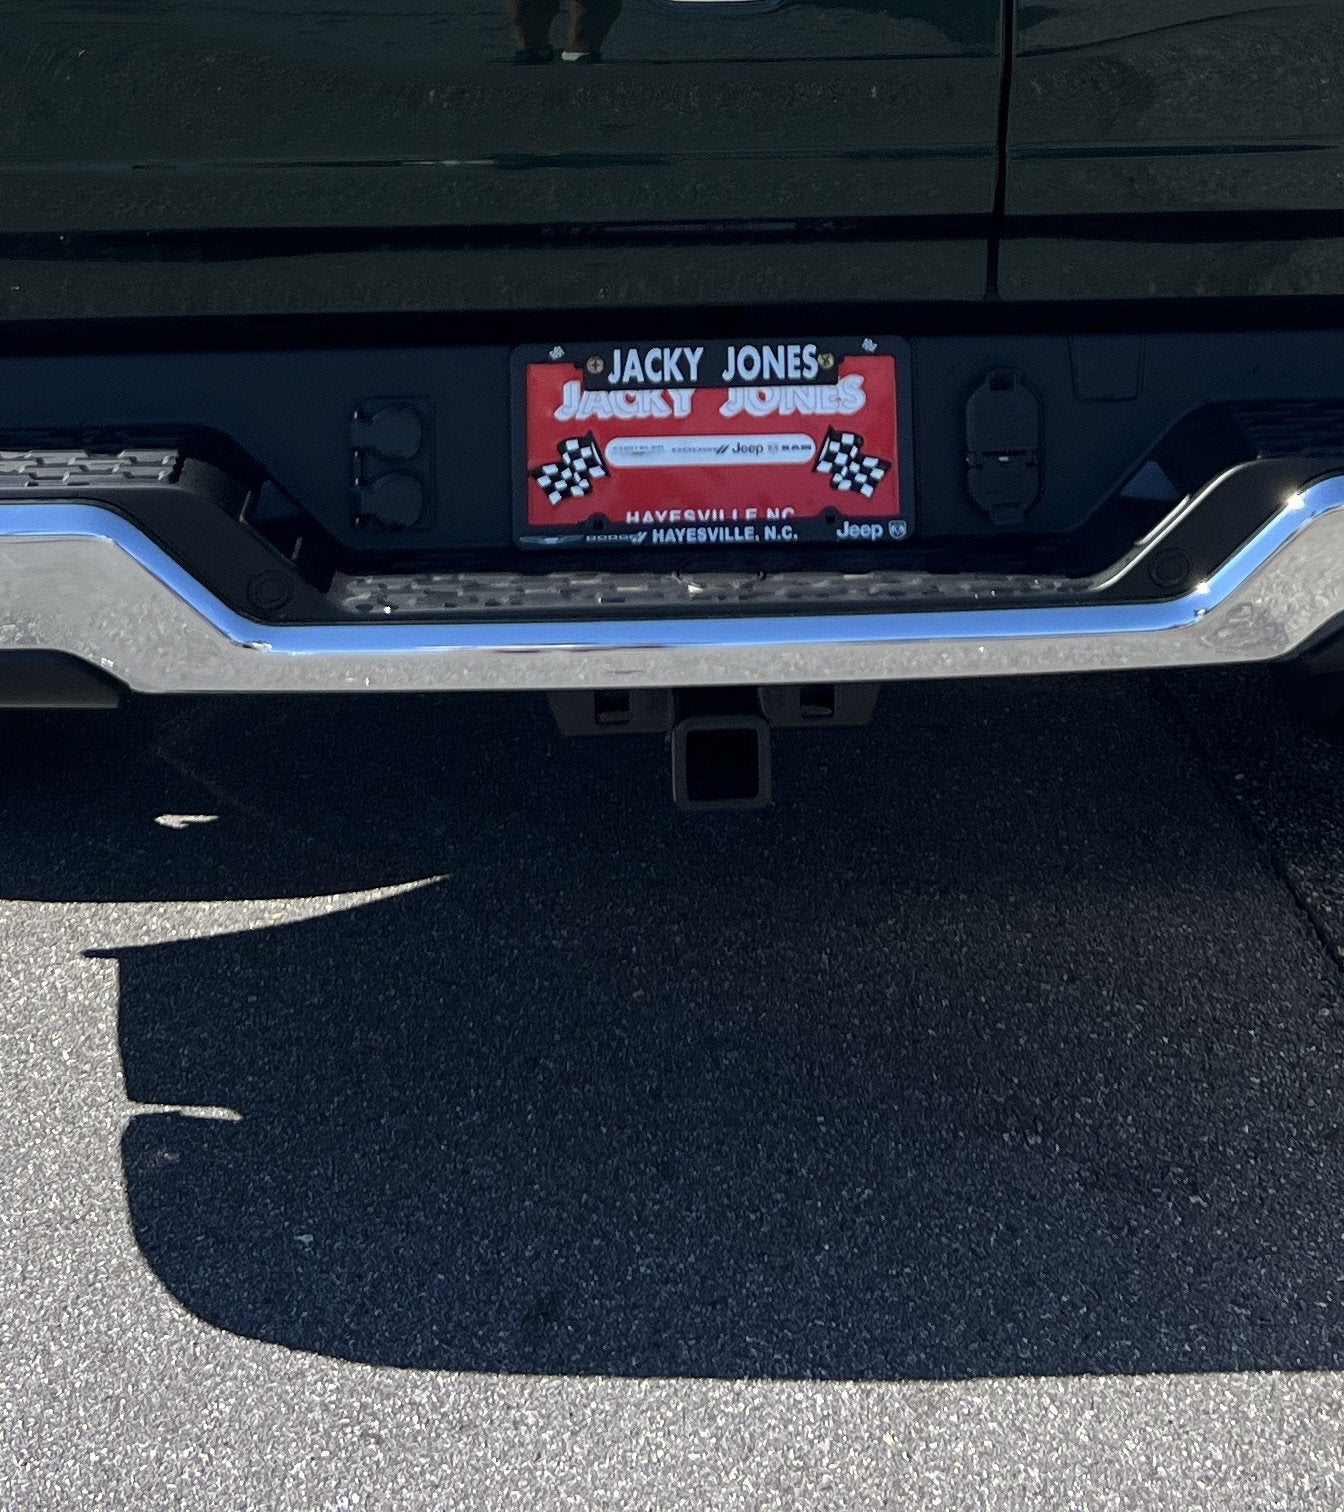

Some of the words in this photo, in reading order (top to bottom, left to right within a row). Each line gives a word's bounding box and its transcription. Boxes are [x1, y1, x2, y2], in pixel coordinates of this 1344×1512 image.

[608, 347, 704, 384] JACKY
[722, 344, 819, 381] JONES
[554, 380, 696, 421] JACKY
[719, 374, 867, 417] JONES
[732, 442, 764, 456] Jeep
[652, 525, 760, 543] HAYESVILLE,
[836, 520, 884, 541] Jeep
